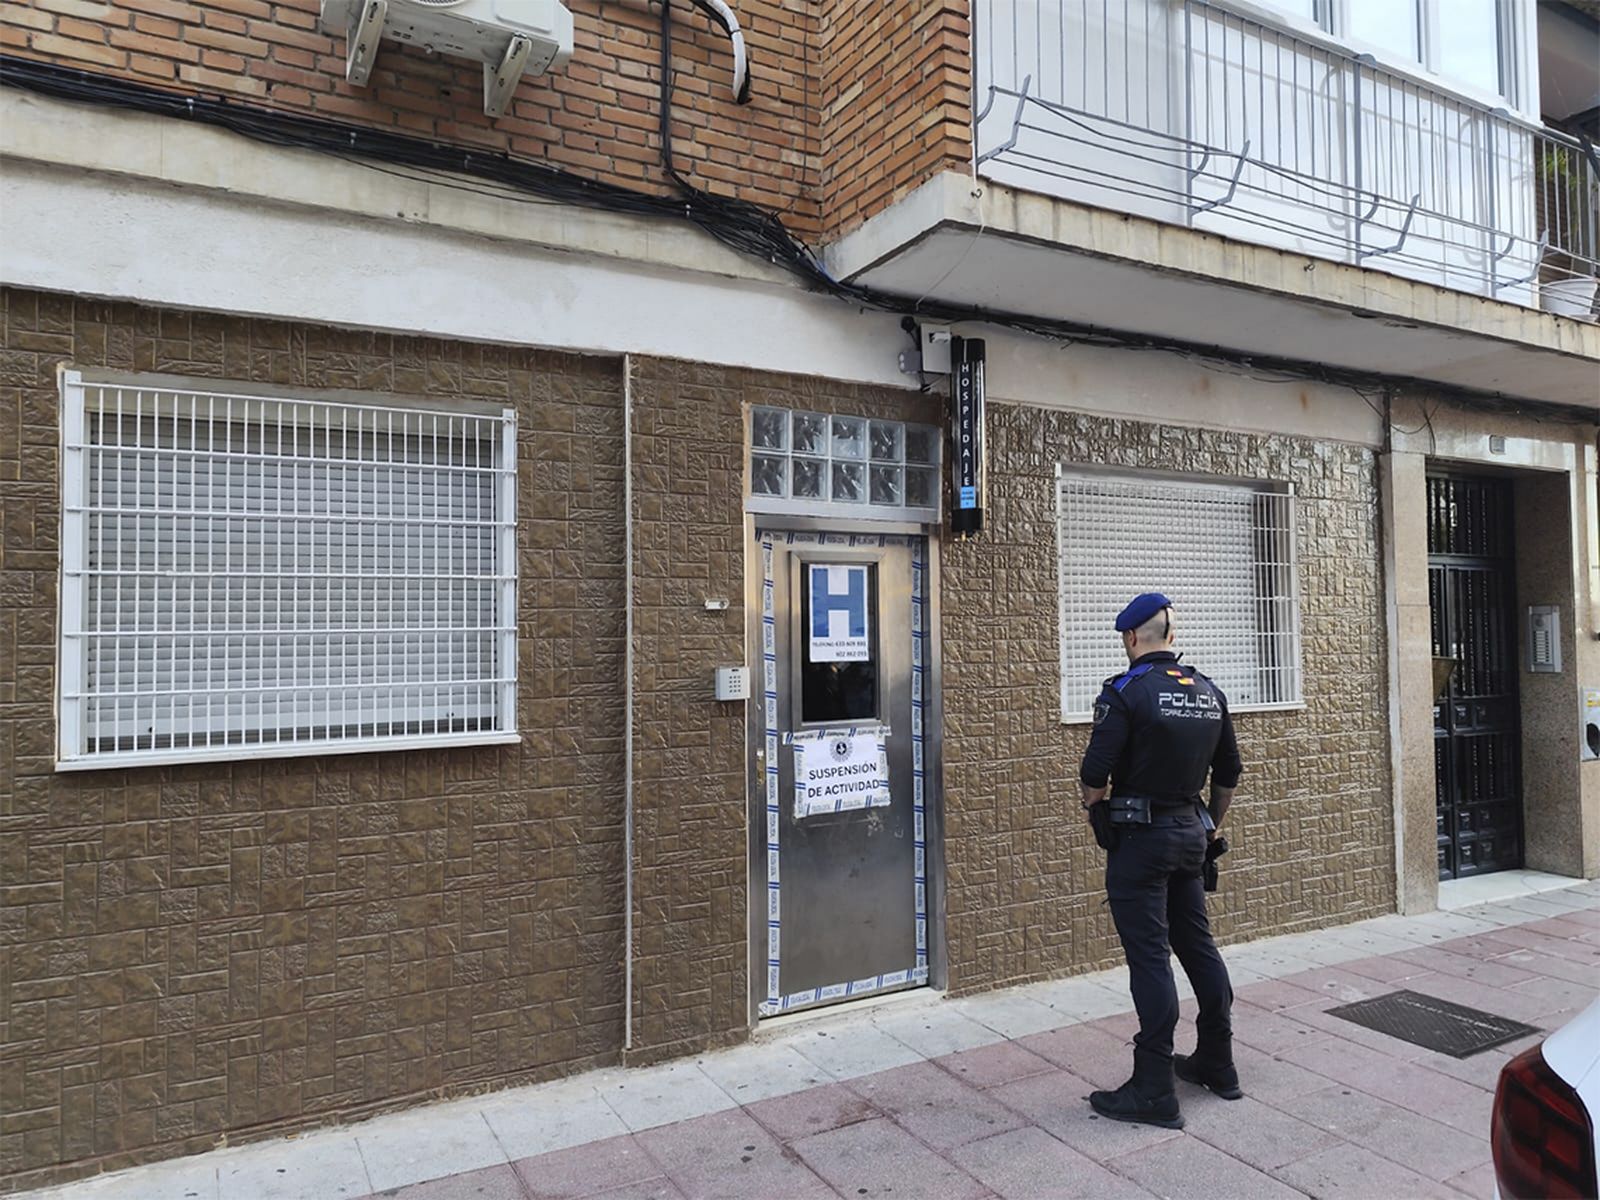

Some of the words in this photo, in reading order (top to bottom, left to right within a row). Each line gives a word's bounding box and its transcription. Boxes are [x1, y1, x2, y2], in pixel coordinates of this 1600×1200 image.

[961, 364, 971, 486] HOSPEDAJE
[812, 568, 865, 638] H
[808, 761, 877, 780] SUSPENSIÓN
[808, 786, 823, 798] DE
[824, 779, 880, 796] ACTIVIDAD
